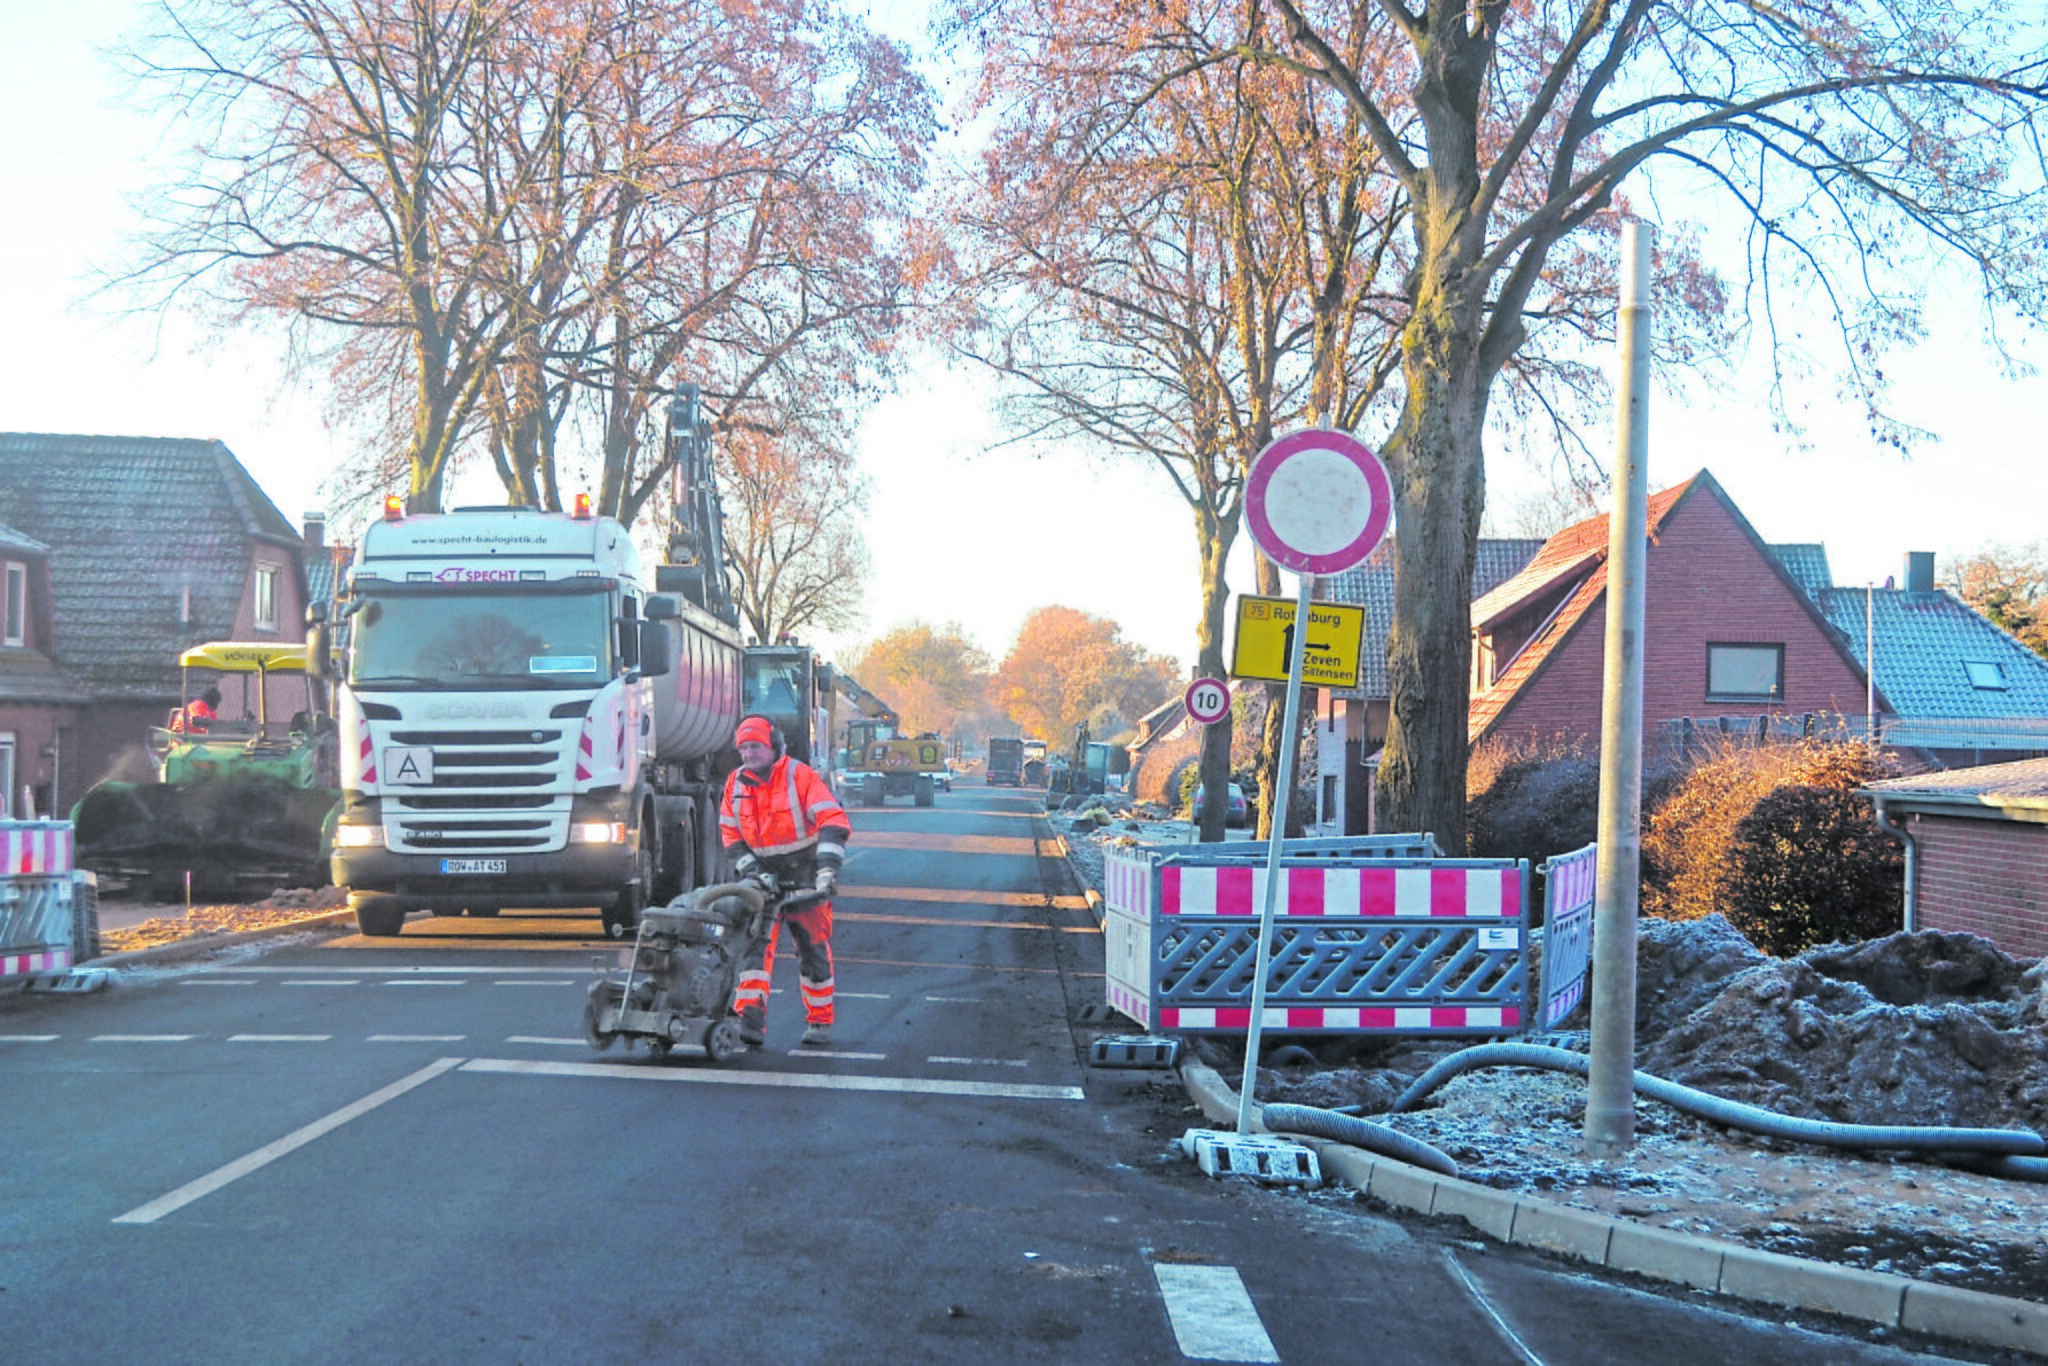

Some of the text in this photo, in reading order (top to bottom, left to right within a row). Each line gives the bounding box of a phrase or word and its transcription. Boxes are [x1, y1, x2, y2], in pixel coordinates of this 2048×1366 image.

[412, 535, 548, 545] www.specht-baulogistik.de
[466, 570, 517, 582] SPECHT
[1251, 604, 1341, 628] 75 Rotburg
[1303, 652, 1341, 667] Zeven
[1302, 665, 1353, 680] Sittensen
[1197, 691, 1218, 710] 10
[424, 700, 529, 720] SCANIA
[397, 751, 421, 779] A
